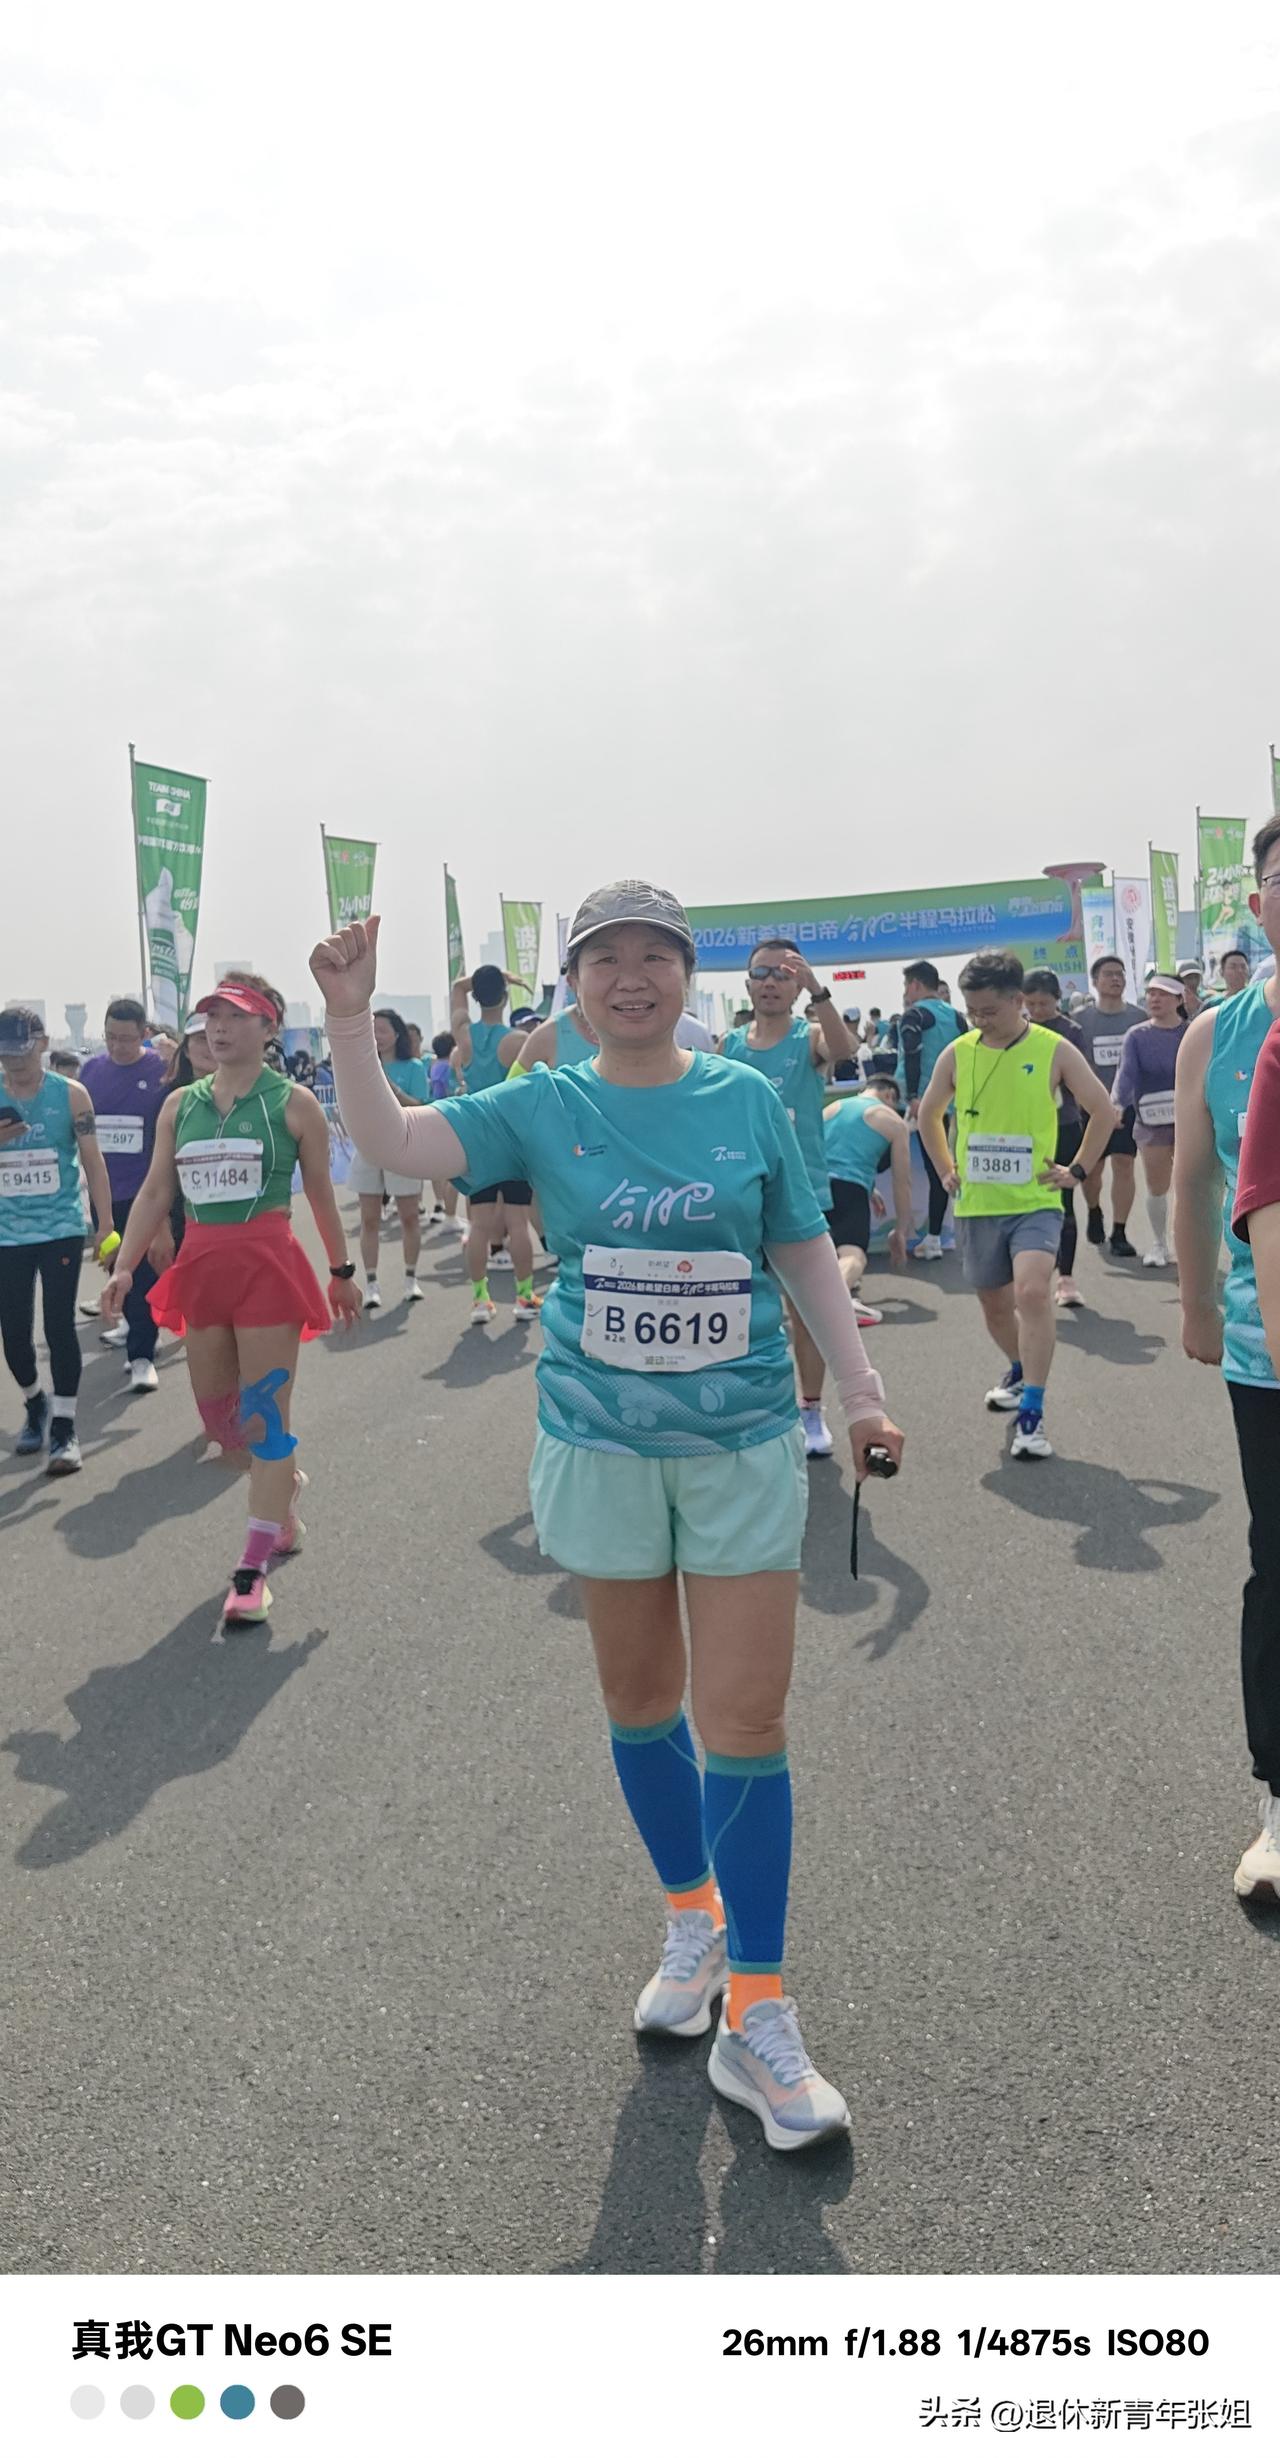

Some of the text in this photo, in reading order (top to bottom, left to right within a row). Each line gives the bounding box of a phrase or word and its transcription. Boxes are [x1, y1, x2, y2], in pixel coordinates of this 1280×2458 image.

[982, 1158, 1020, 1173] 3881
[13, 1170, 52, 1186] 9415
[191, 1168, 249, 1188] C 11484
[600, 1177, 716, 1233] 合肥
[605, 1305, 728, 1345] B 6619
